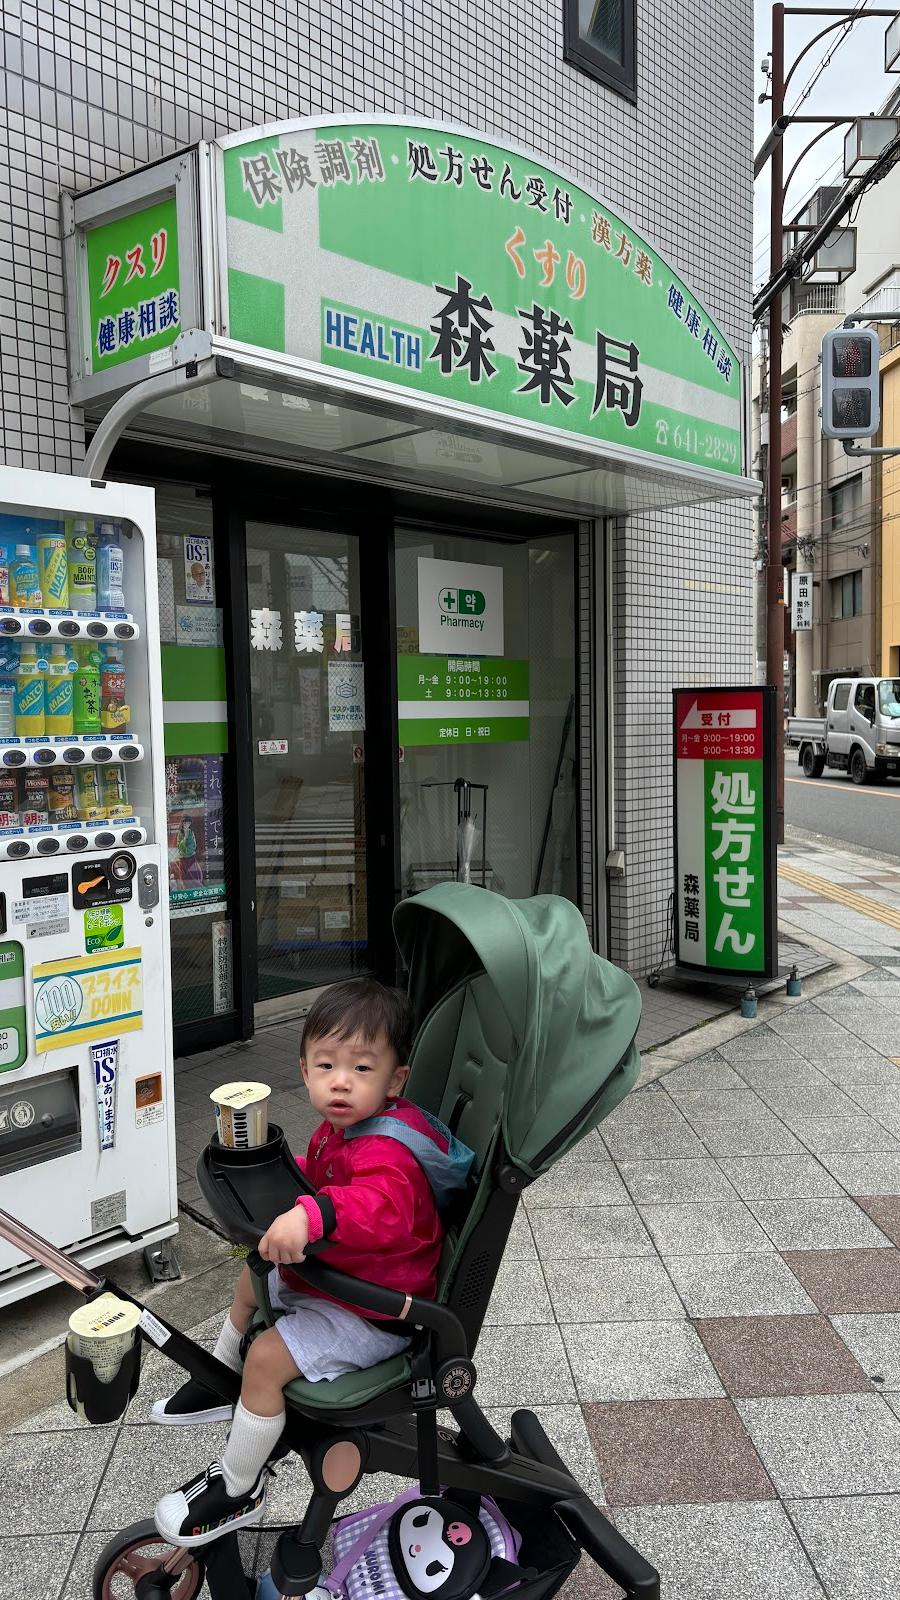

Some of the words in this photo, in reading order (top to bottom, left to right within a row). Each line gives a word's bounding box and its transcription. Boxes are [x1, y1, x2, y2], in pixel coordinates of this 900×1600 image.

[100, 228, 167, 298] クスリ
[242, 137, 386, 206] 保険調剤
[406, 140, 574, 225] 処方せん受付
[591, 210, 657, 287] 漢方薬
[665, 284, 734, 383] 健康相談
[505, 227, 587, 300] くすり
[96, 288, 180, 355] 健康相談
[325, 309, 421, 369] HEALTH
[427, 275, 645, 428] 森薬局
[674, 425, 736, 464] 641-2829
[186, 544, 209, 562] OS-1
[77, 565, 95, 575] BODY
[799, 576, 808, 598] 原田
[465, 593, 476, 612] 약
[440, 614, 485, 631] Pharmacy
[448, 660, 481, 673] 開局時間
[425, 689, 432, 697] 土
[701, 712, 731, 726] 受付
[439, 728, 459, 738] 定休日
[711, 771, 756, 955] 処方せん
[684, 873, 700, 943] 森薬局
[87, 937, 101, 946] ECO
[81, 967, 140, 995] プライス
[40, 980, 76, 1023] 100
[91, 991, 132, 1018] DOWN
